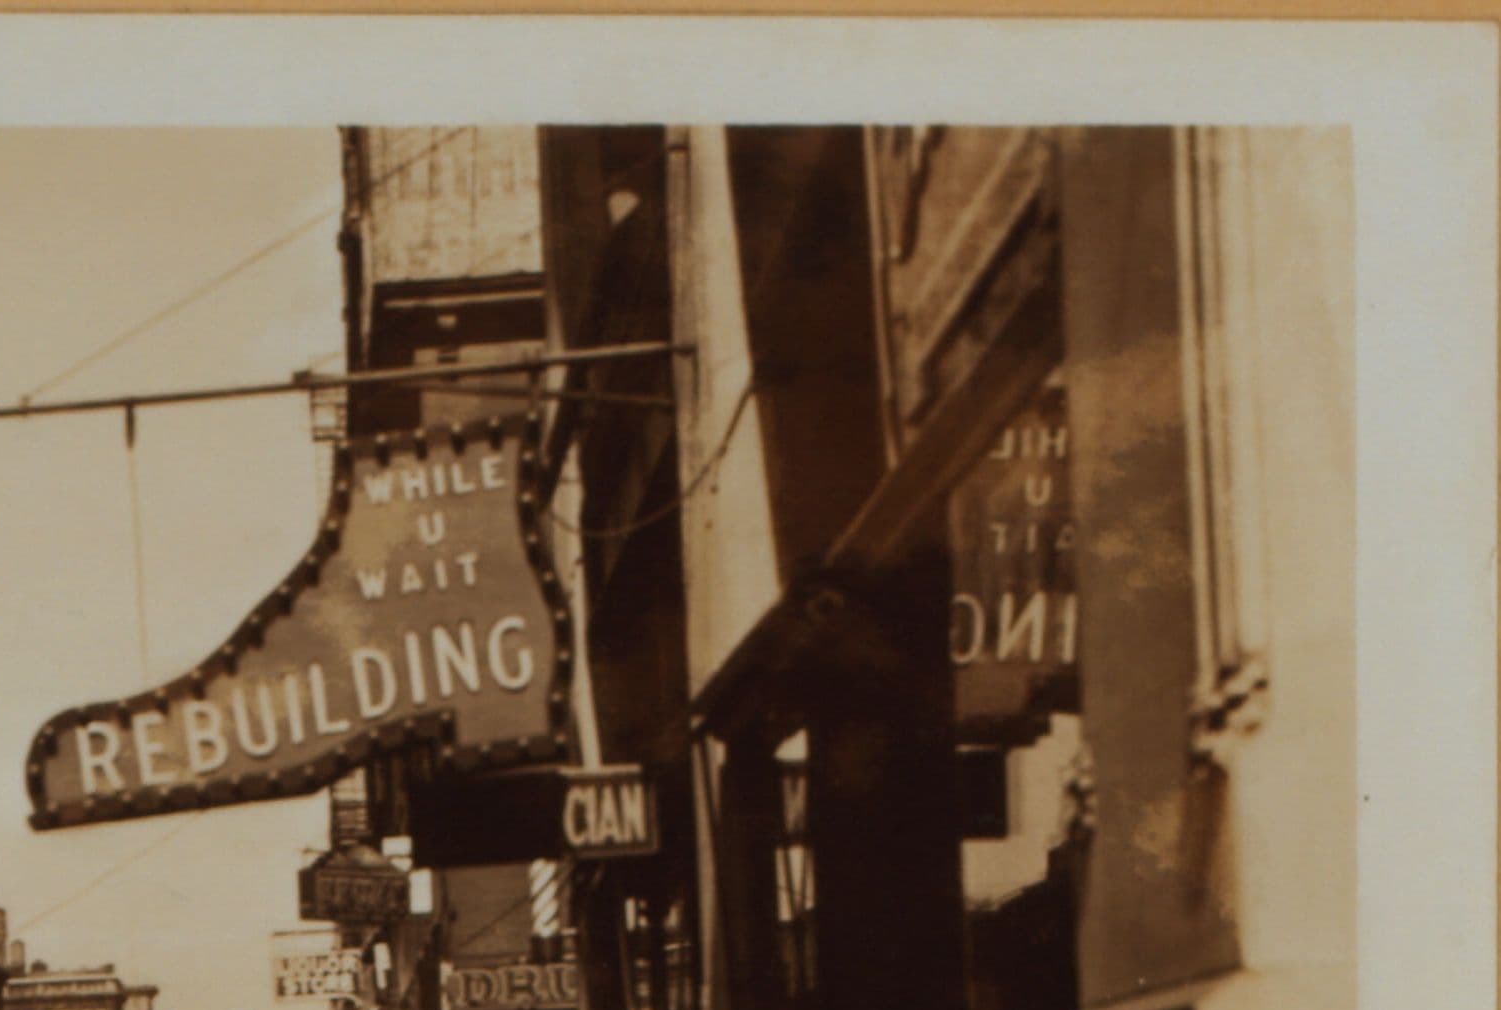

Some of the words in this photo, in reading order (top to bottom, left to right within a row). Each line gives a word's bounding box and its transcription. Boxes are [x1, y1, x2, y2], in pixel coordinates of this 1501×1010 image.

[362, 455, 508, 505] WHILE
[416, 511, 447, 546] U
[356, 550, 482, 601] WAIT
[75, 613, 535, 794] REBUILDING
